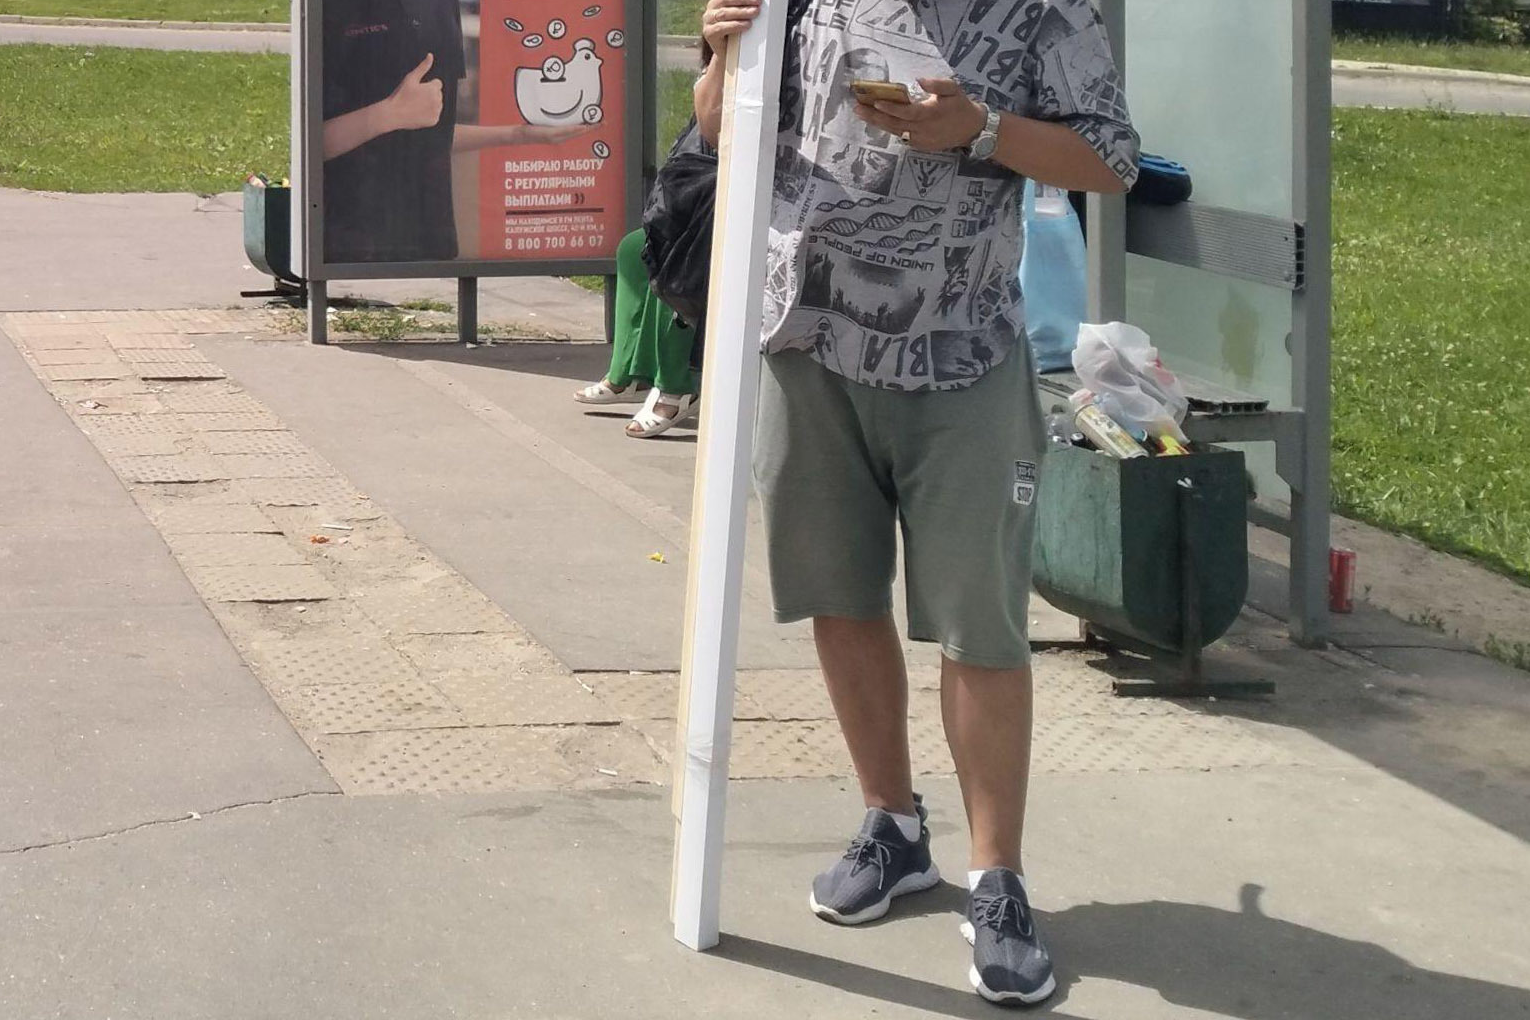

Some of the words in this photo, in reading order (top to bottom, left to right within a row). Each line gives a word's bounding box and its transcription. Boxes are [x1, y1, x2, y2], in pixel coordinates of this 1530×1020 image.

[949, 29, 1023, 86] BLA
[505, 160, 561, 173] ВЫБИРАЮ
[563, 158, 604, 172] РАБОТУ
[505, 178, 512, 190] С
[514, 176, 596, 190] РЕГУЛЯРНЫМИ
[504, 192, 572, 207] ВЫПЛАТАМИ
[505, 237, 513, 250] 8
[517, 237, 541, 250] 800
[545, 236, 566, 249] 700
[570, 235, 584, 248] 66
[589, 235, 604, 248] 07
[807, 234, 863, 259] PEOPLE
[865, 252, 887, 265] OF
[890, 260, 935, 272] UNION
[863, 333, 929, 379] BLA
